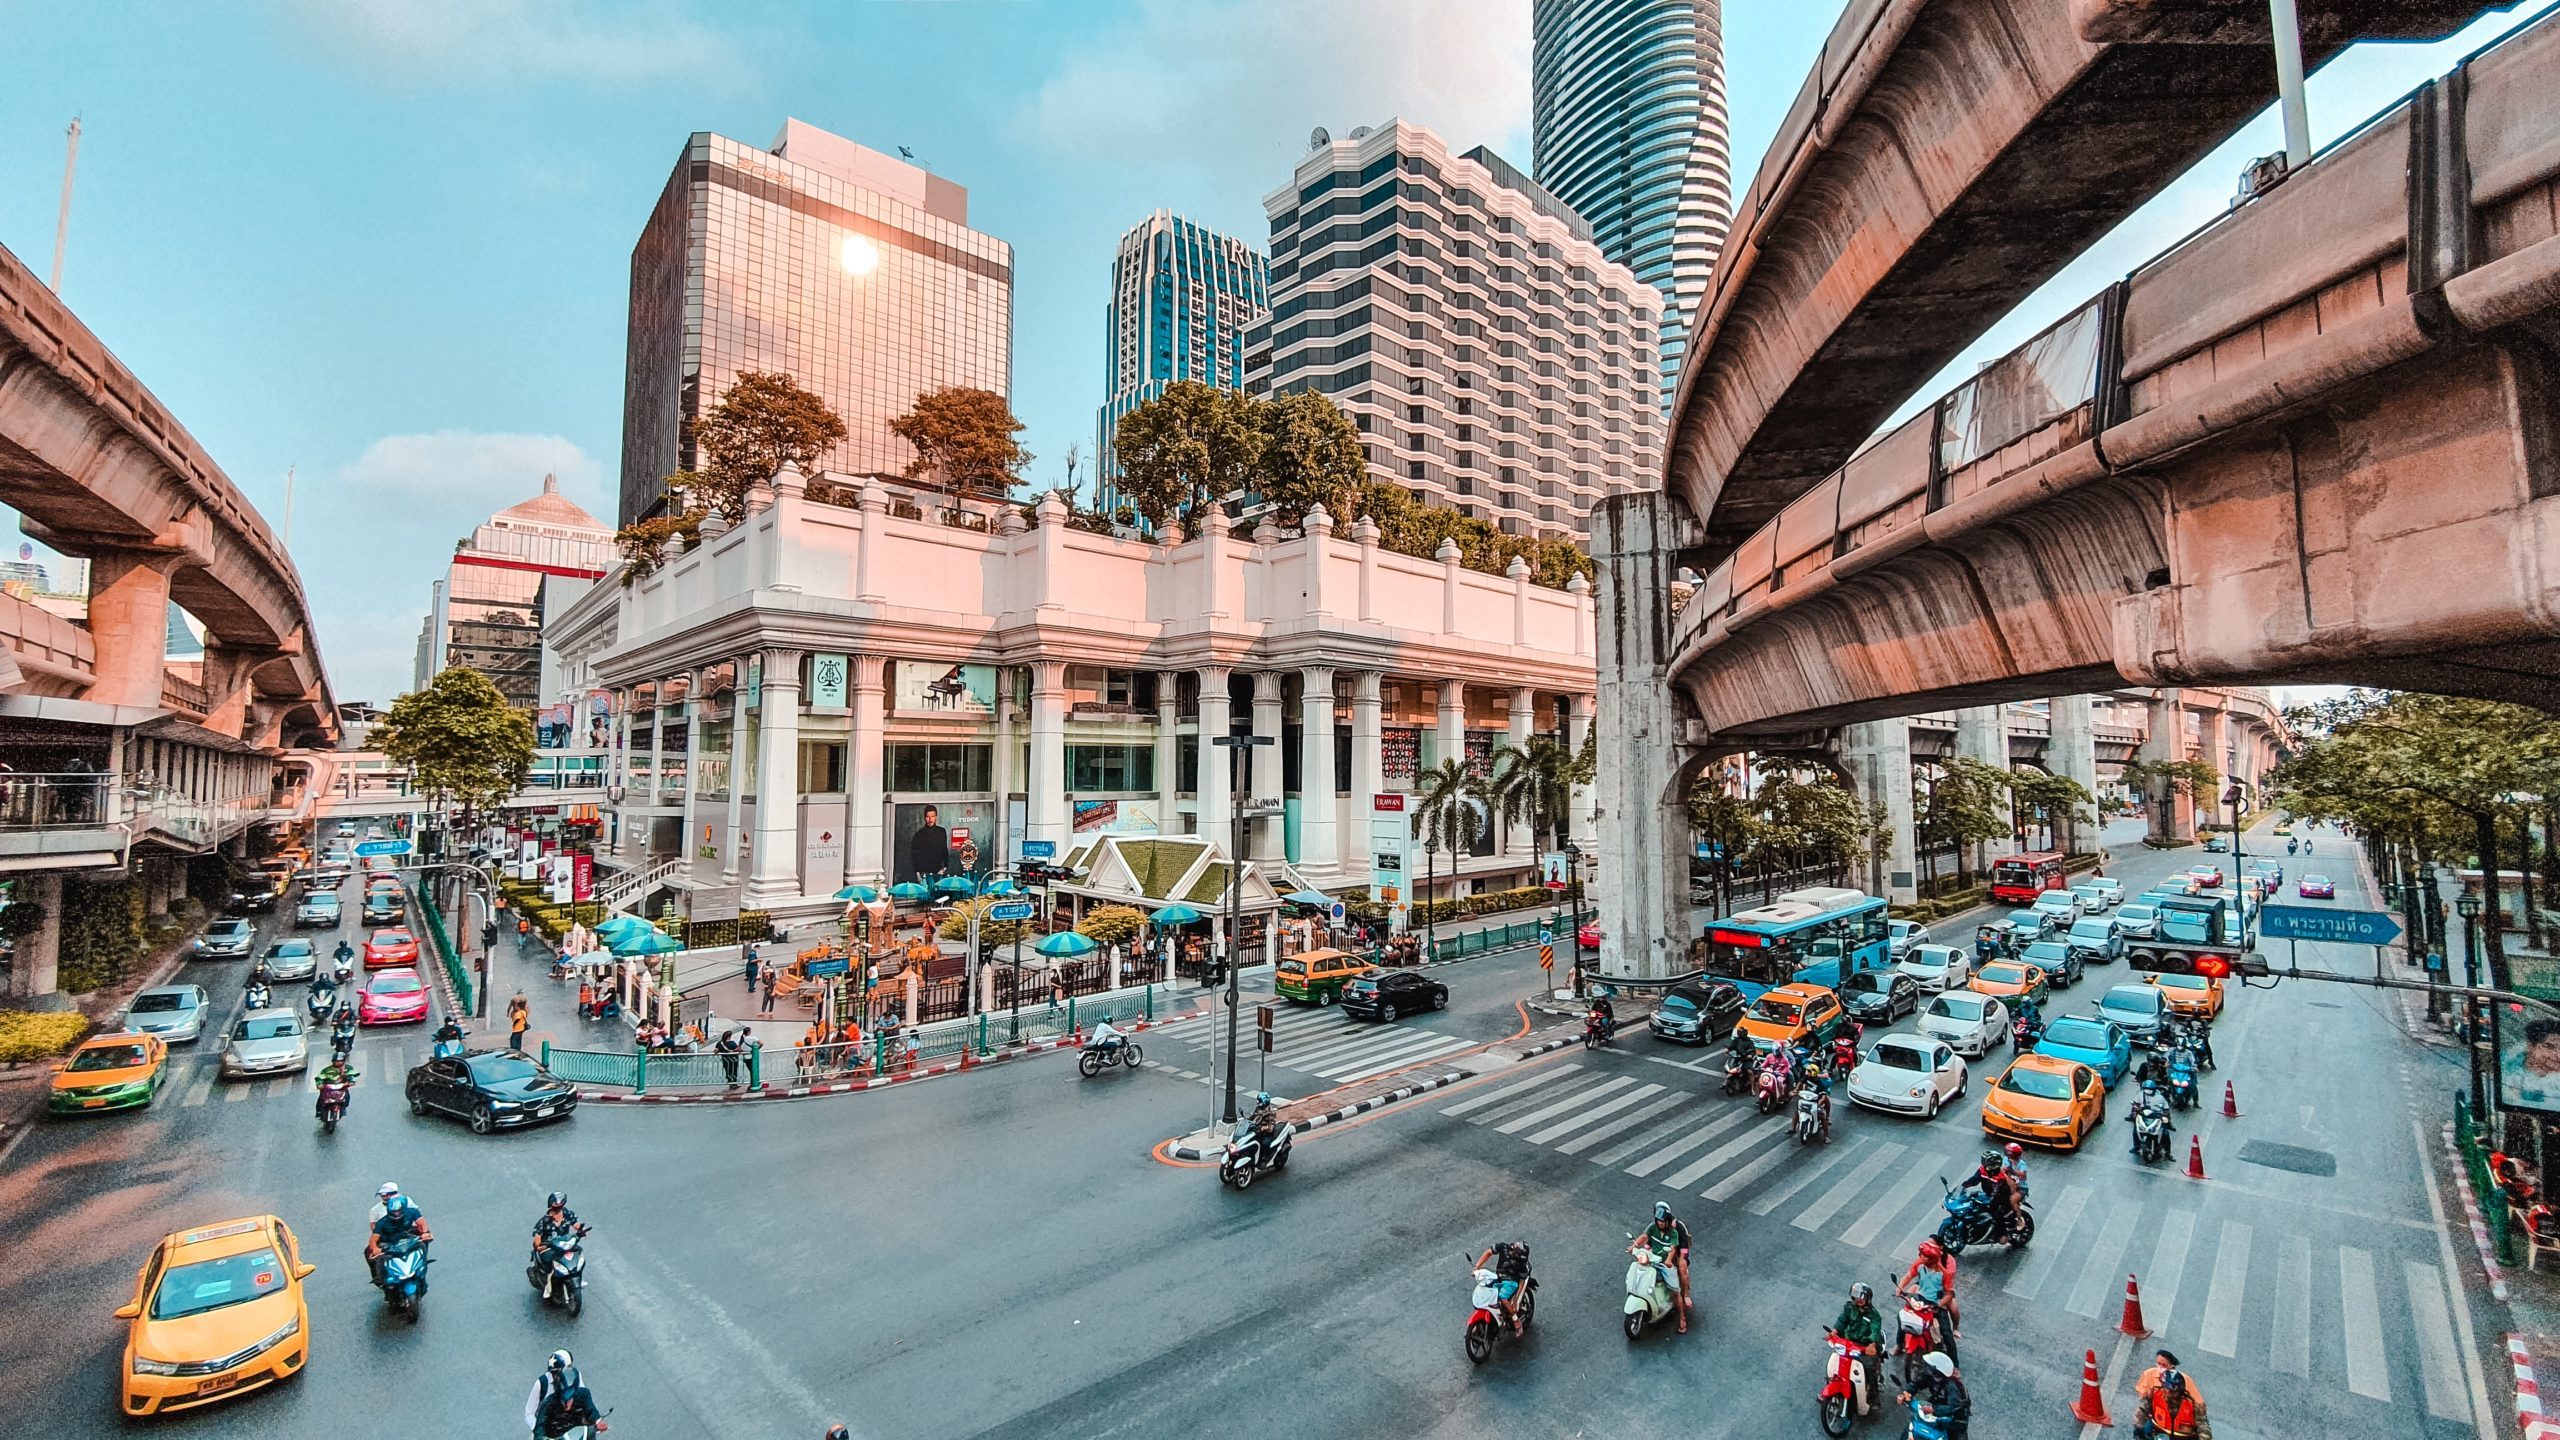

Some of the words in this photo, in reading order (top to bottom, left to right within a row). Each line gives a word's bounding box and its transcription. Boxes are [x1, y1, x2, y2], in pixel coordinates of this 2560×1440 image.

[1376, 797, 1401, 806] ERAWAN
[580, 863, 590, 893] ERAWAN
[2287, 912, 2357, 932] พระรามที่
[2359, 923, 2373, 934] ๑
[2294, 929, 2323, 938] Rama
